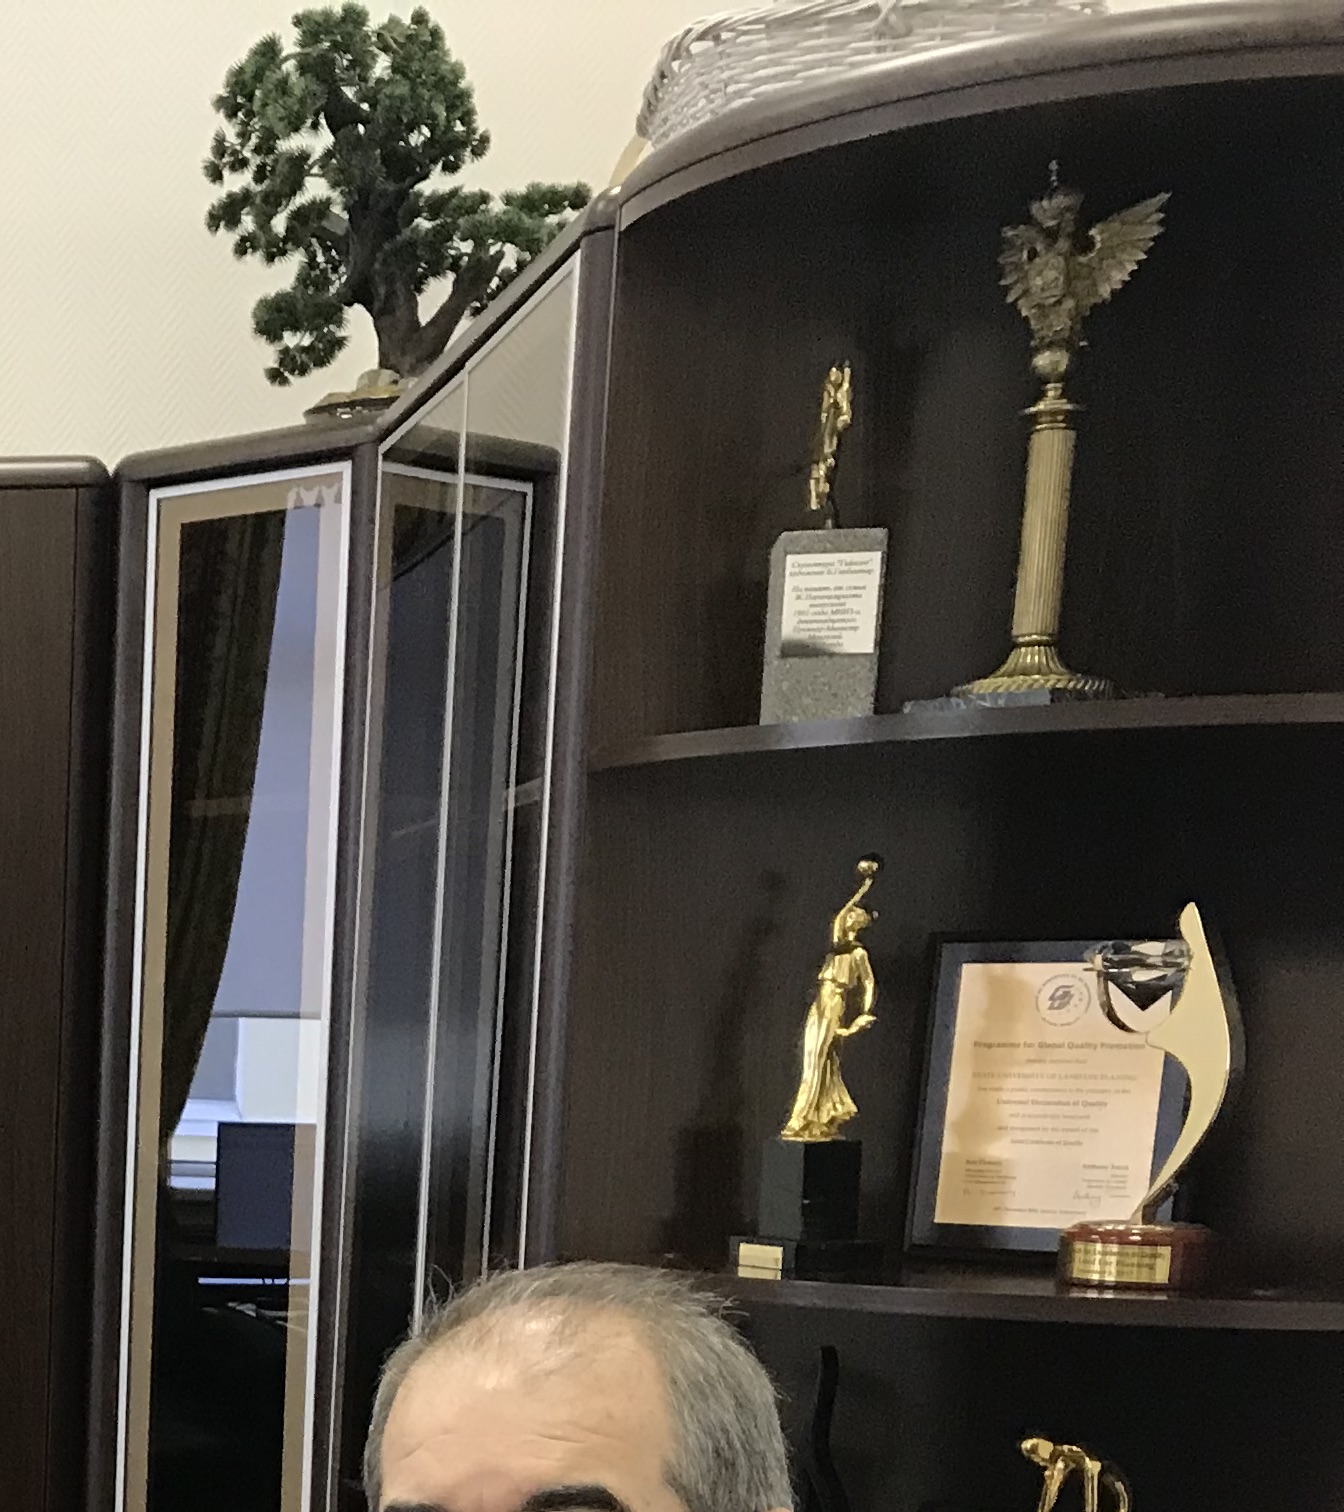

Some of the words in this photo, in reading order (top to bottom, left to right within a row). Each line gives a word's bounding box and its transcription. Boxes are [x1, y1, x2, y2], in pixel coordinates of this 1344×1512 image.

[973, 1040, 1021, 1050] Programme
[1023, 1040, 1036, 1049] for
[1037, 1041, 1066, 1050] Global
[1067, 1041, 1098, 1051] Quality
[1081, 1099, 1109, 1109] Quality
